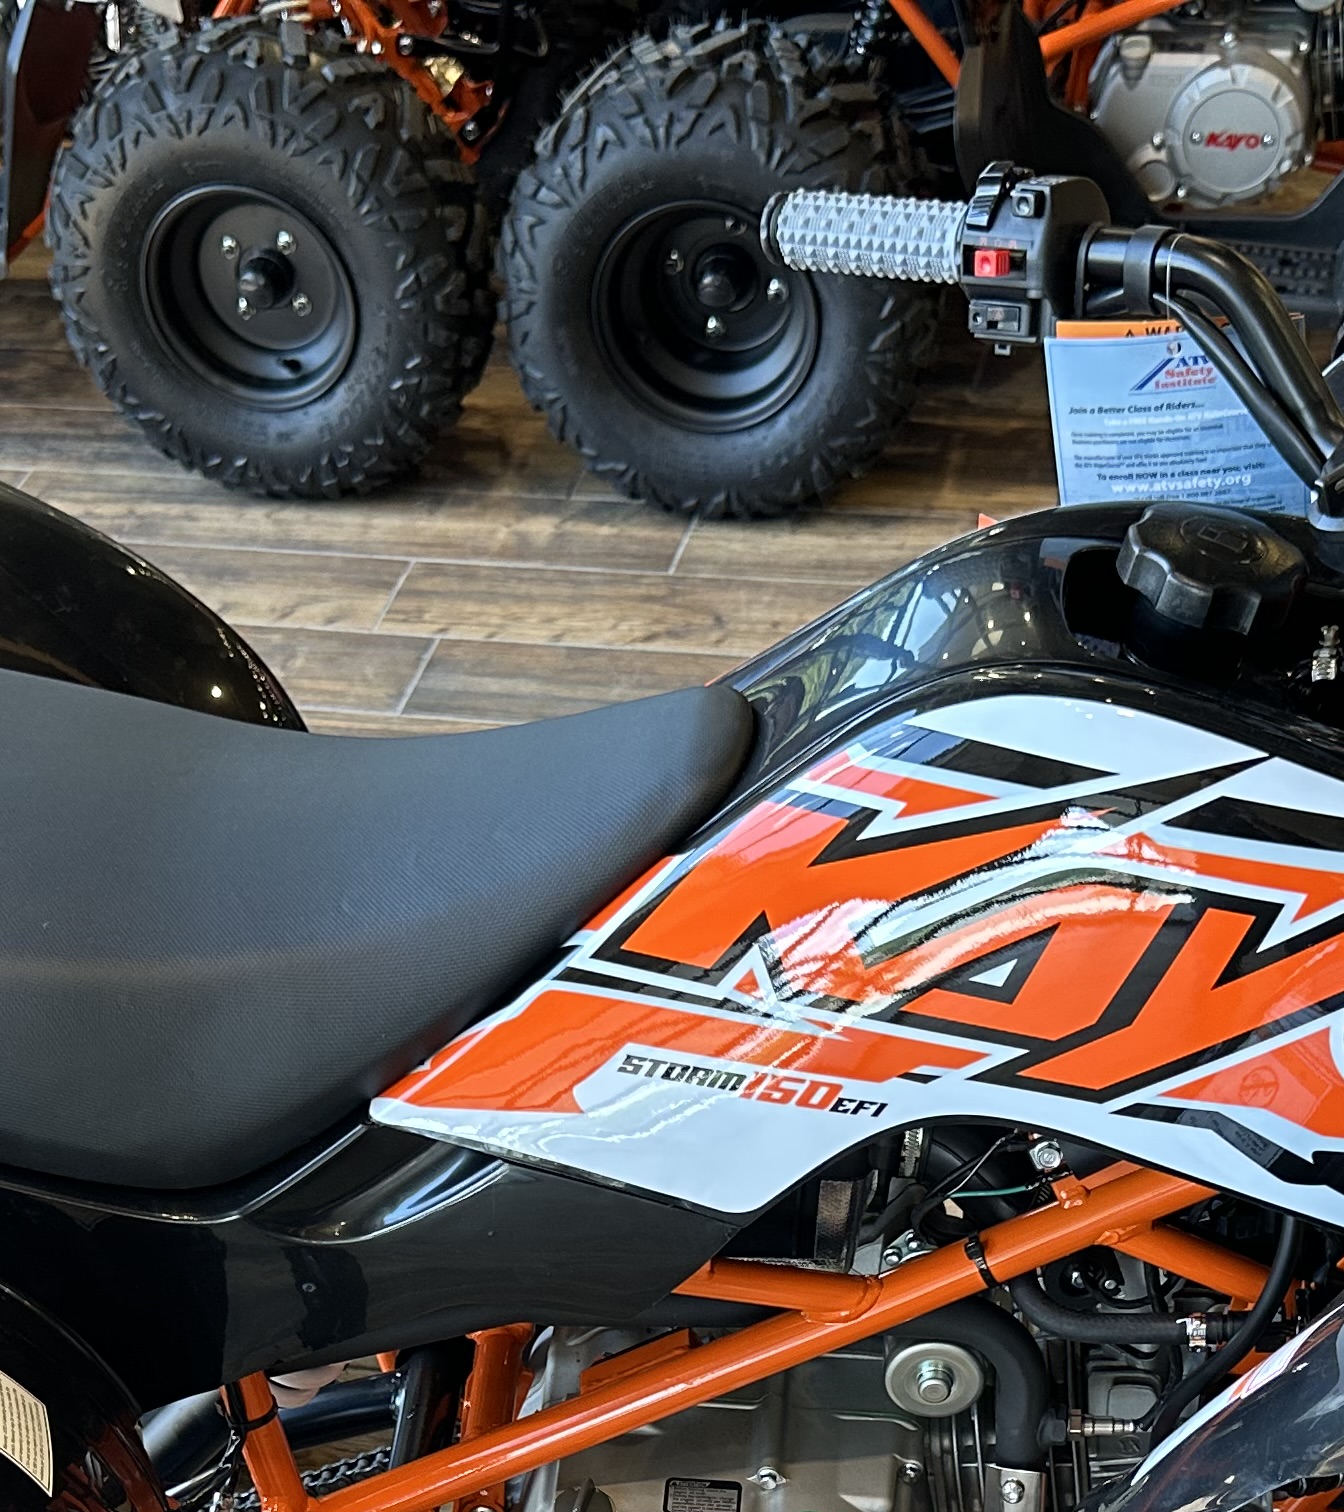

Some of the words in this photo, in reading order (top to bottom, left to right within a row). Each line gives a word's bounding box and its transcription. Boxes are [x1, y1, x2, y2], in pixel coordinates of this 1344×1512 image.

[1205, 128, 1261, 152] KAYO
[1164, 366, 1214, 380] Safety
[1154, 376, 1216, 390] Institute
[1068, 406, 1087, 415] Join
[1097, 406, 1125, 414] Better
[1127, 404, 1152, 414] Class
[1153, 402, 1164, 412] of
[1135, 472, 1158, 480] NOW
[1111, 474, 1251, 493] www.atvsafety.org
